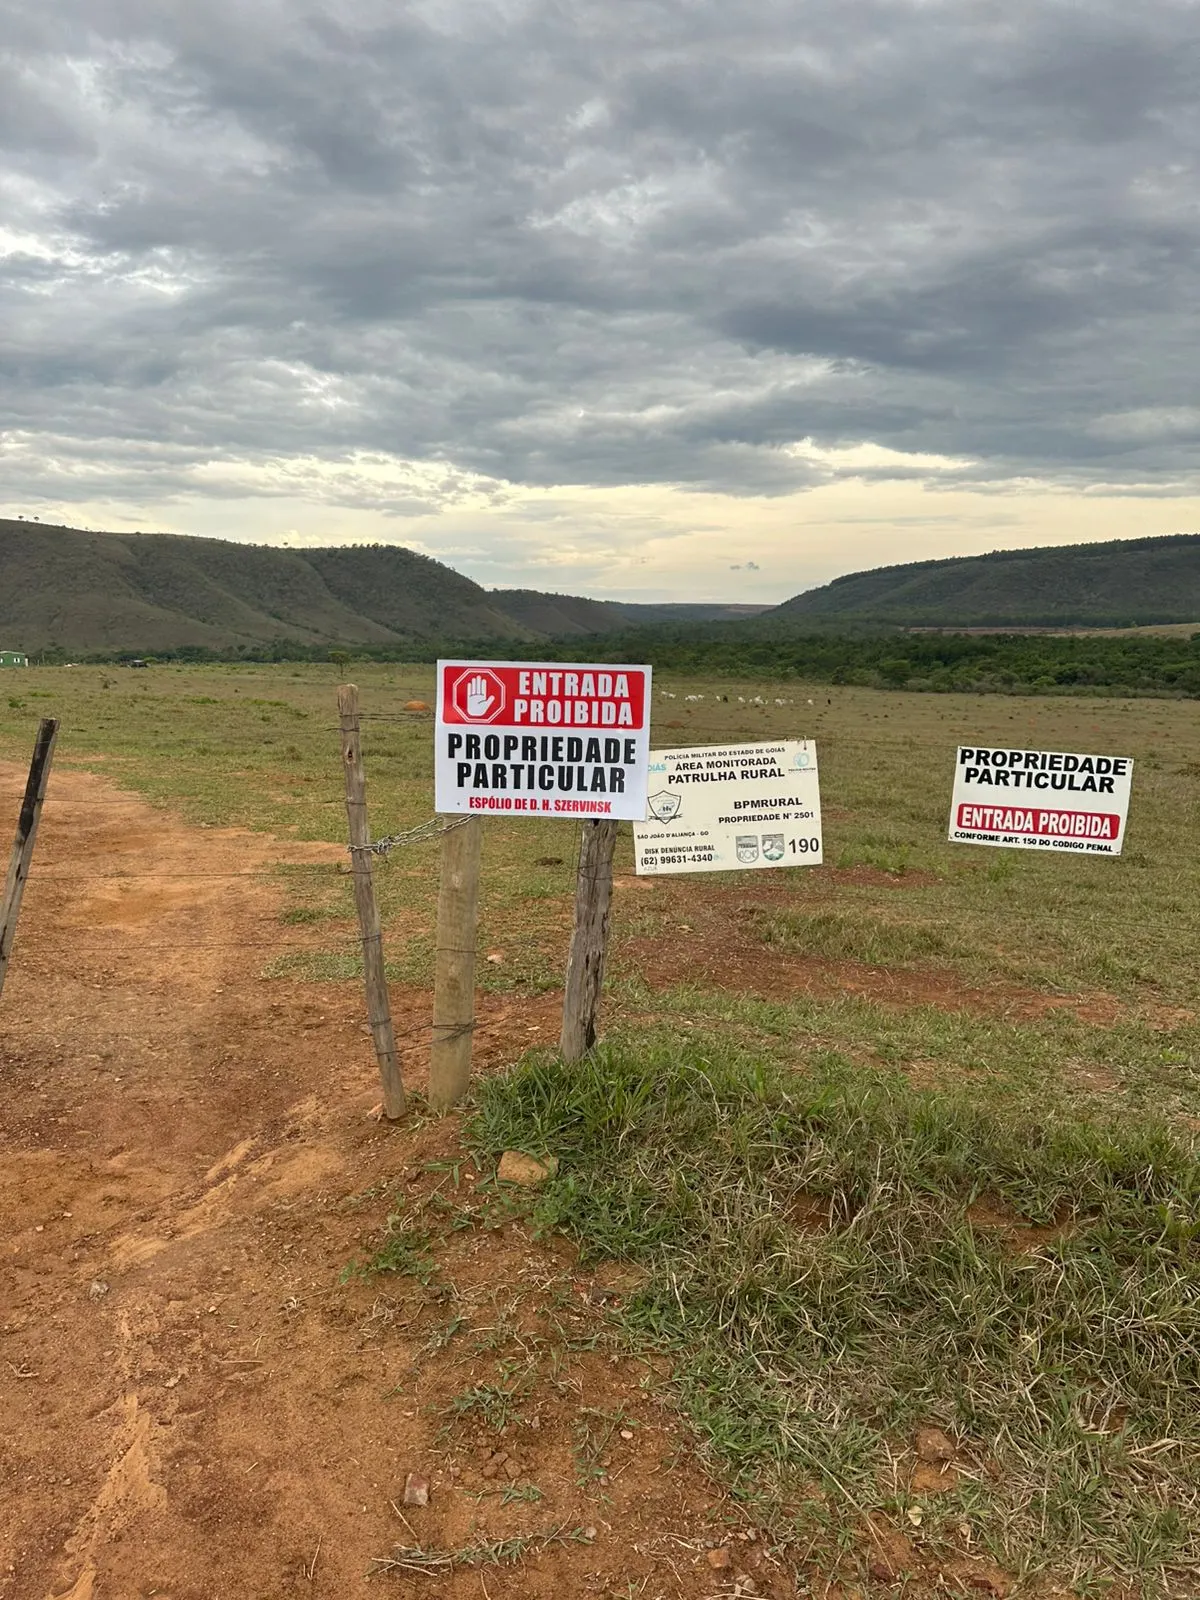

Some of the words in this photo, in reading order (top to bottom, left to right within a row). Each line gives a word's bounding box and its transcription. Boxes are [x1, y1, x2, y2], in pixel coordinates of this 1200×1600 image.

[519, 672, 629, 697] ENTRADA
[514, 699, 633, 725] PROIBIDA
[448, 733, 636, 764] PROPRIEDADE
[648, 763, 666, 772] OIÁS
[675, 761, 702, 771] ÁREA
[706, 757, 776, 769] MONITORADA
[960, 749, 1127, 775] PROPRIEDADE
[457, 762, 625, 793] PARTICULAR
[668, 770, 736, 784] PATRULHA
[740, 768, 784, 780] RURAL
[965, 768, 1114, 793] PARTICULAR
[470, 795, 511, 809] ESPÓLIO
[514, 799, 527, 810] DE
[530, 800, 539, 810] D.
[542, 800, 552, 811] H.
[554, 800, 611, 813] SZERVINSK
[734, 797, 802, 809] BPMRURAL
[718, 814, 780, 824] PROPRIEDADE
[962, 807, 1034, 832] ENTRADA
[1039, 813, 1111, 837] PROIBIDA
[660, 846, 693, 854] DENÚNCIA
[789, 838, 819, 853] 190
[954, 831, 1000, 842] CONFORME
[1053, 840, 1084, 849] CODIGO
[1086, 843, 1112, 852] PENAL
[641, 856, 658, 866] (62)
[660, 854, 713, 864] 99631-4340
